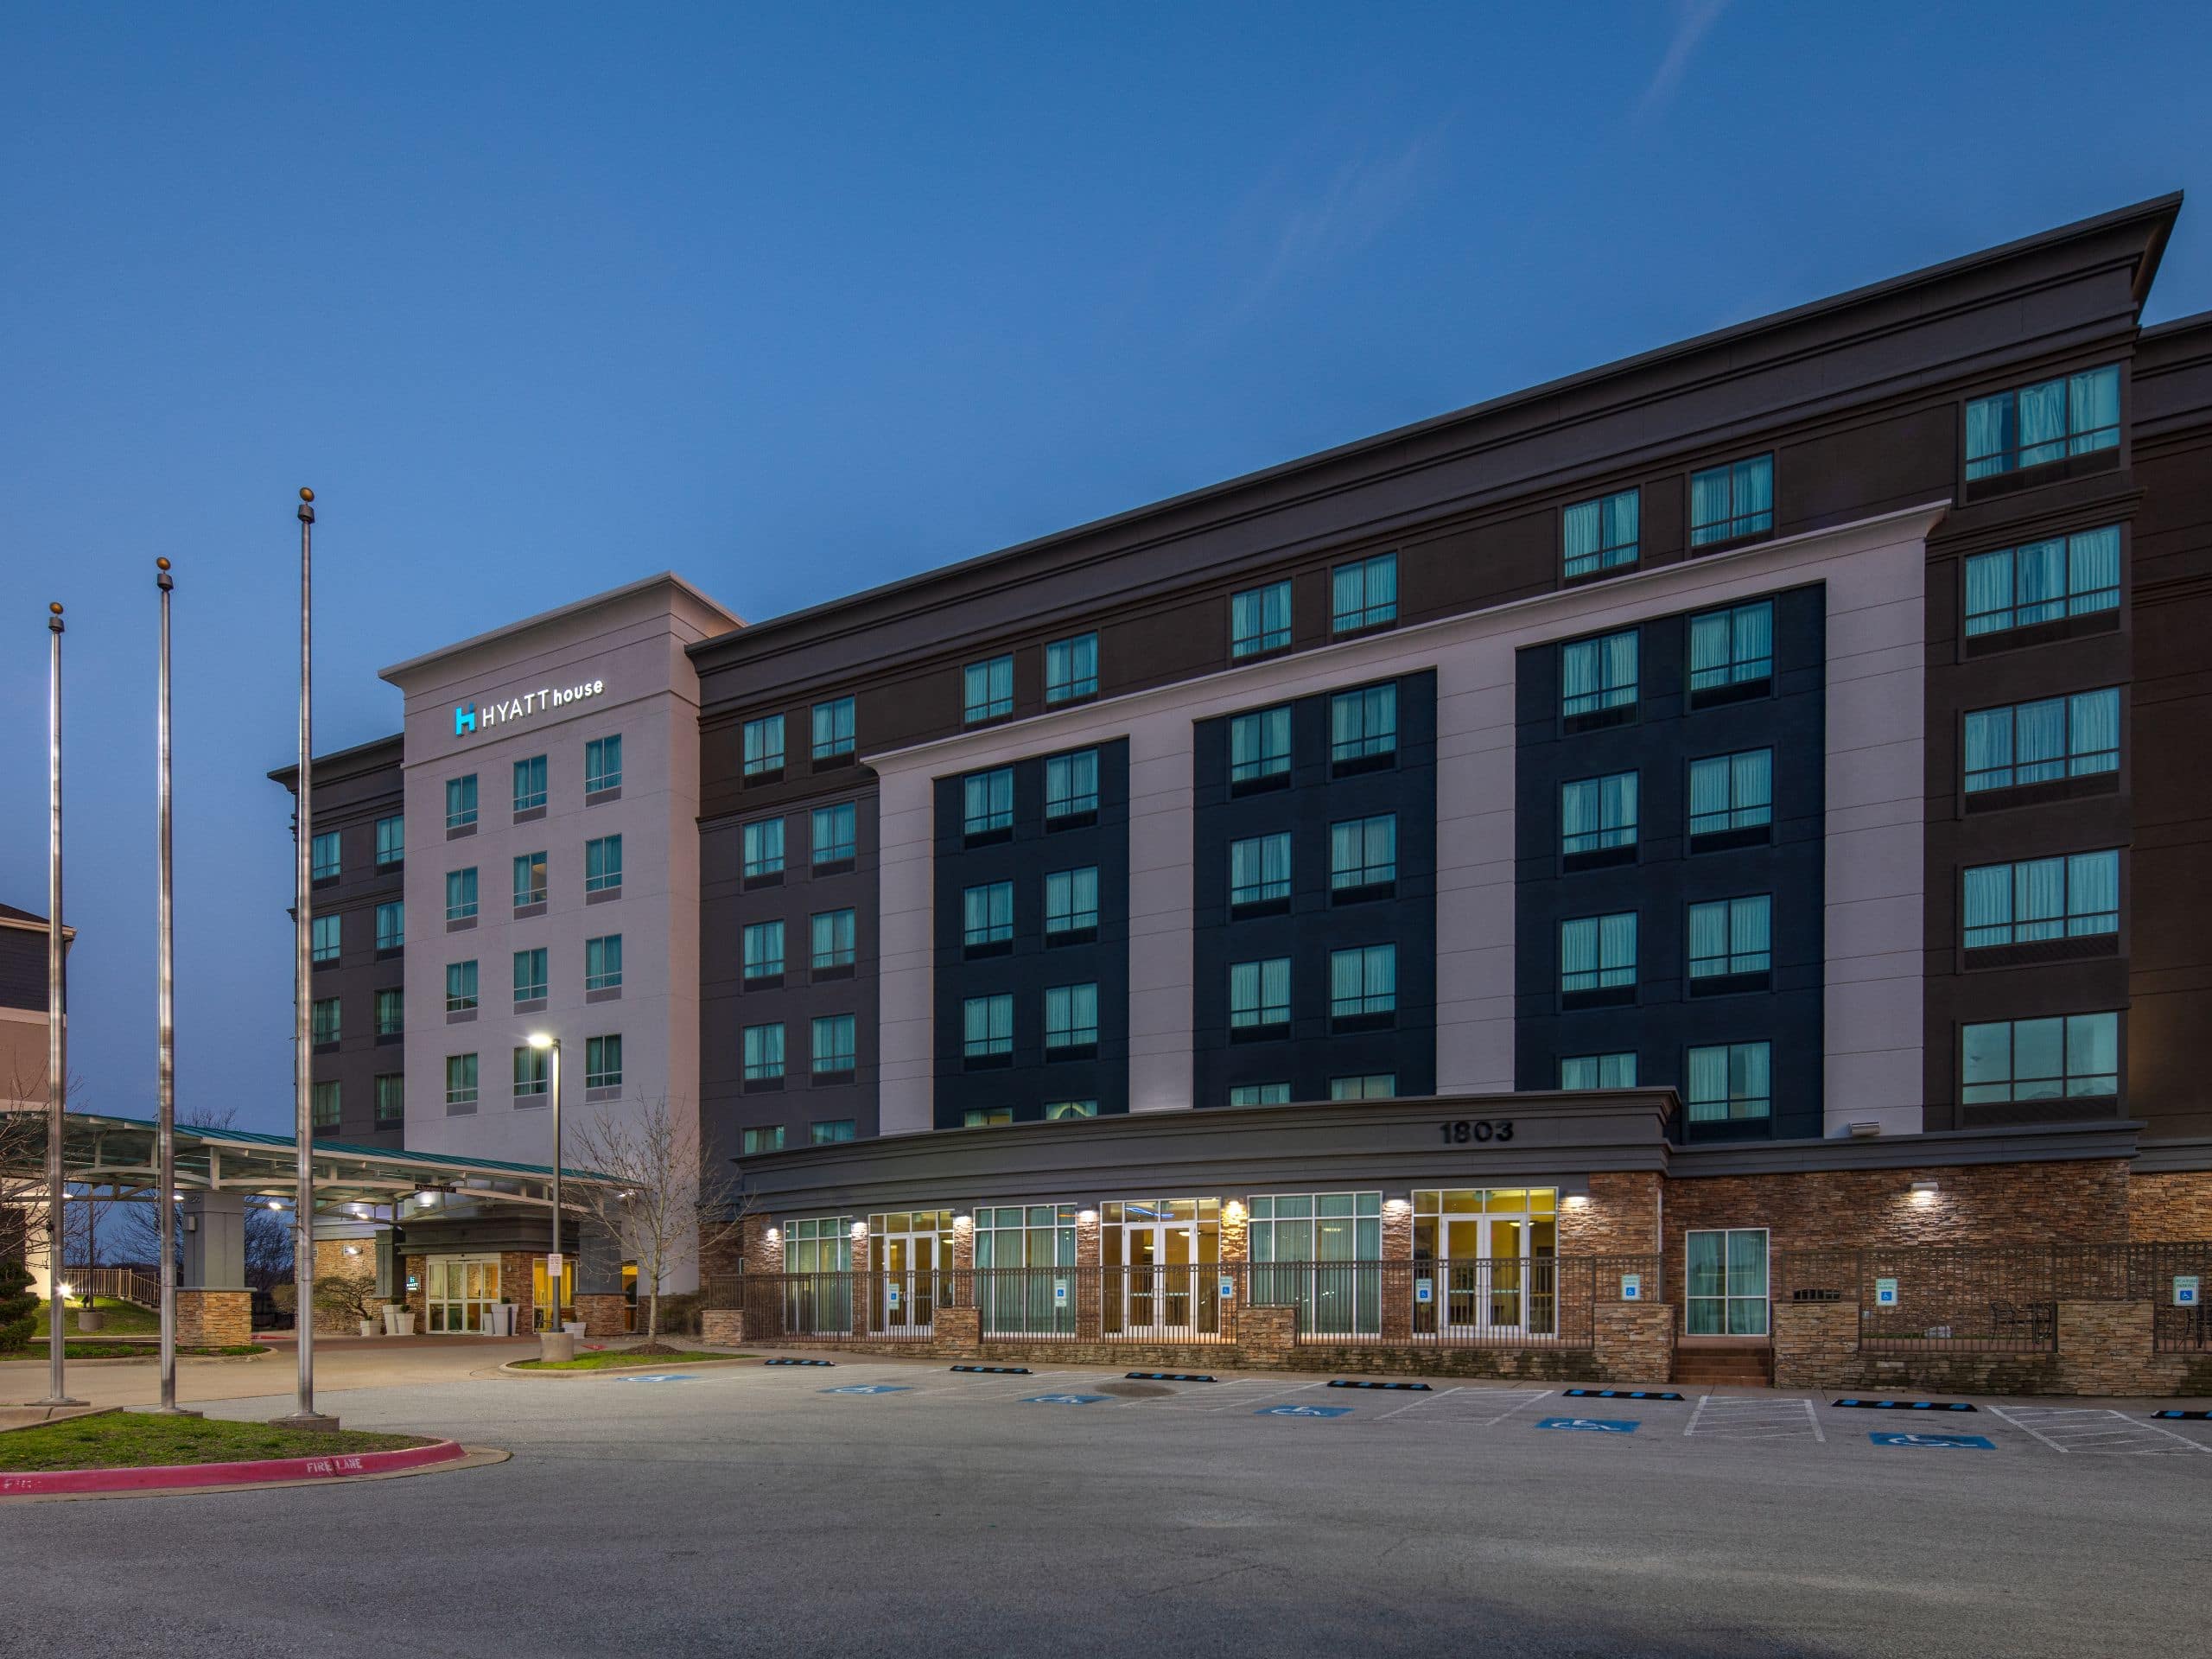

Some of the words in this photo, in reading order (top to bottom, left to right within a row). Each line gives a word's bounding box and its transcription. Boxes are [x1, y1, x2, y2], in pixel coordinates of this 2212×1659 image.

[482, 690, 550, 728] HYATT
[553, 680, 603, 707] house
[1440, 1119, 1514, 1144] 1803
[307, 1460, 333, 1472] FIRE
[336, 1458, 362, 1470] LANE
